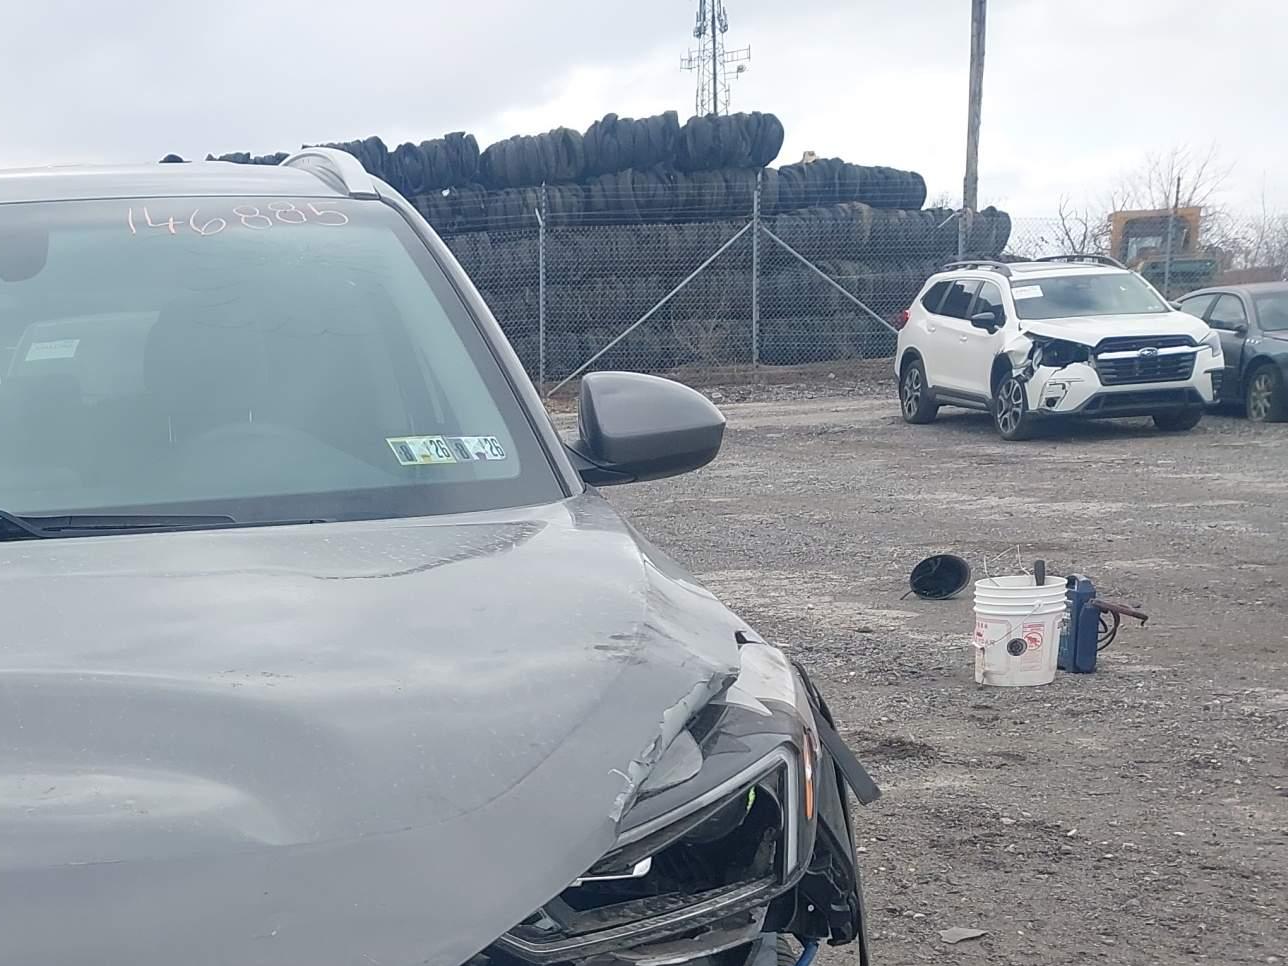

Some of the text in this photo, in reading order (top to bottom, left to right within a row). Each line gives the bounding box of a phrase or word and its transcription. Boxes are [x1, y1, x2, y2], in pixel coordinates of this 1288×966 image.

[128, 201, 349, 235] 146885
[429, 439, 451, 458] 26
[483, 437, 505, 457] 26
